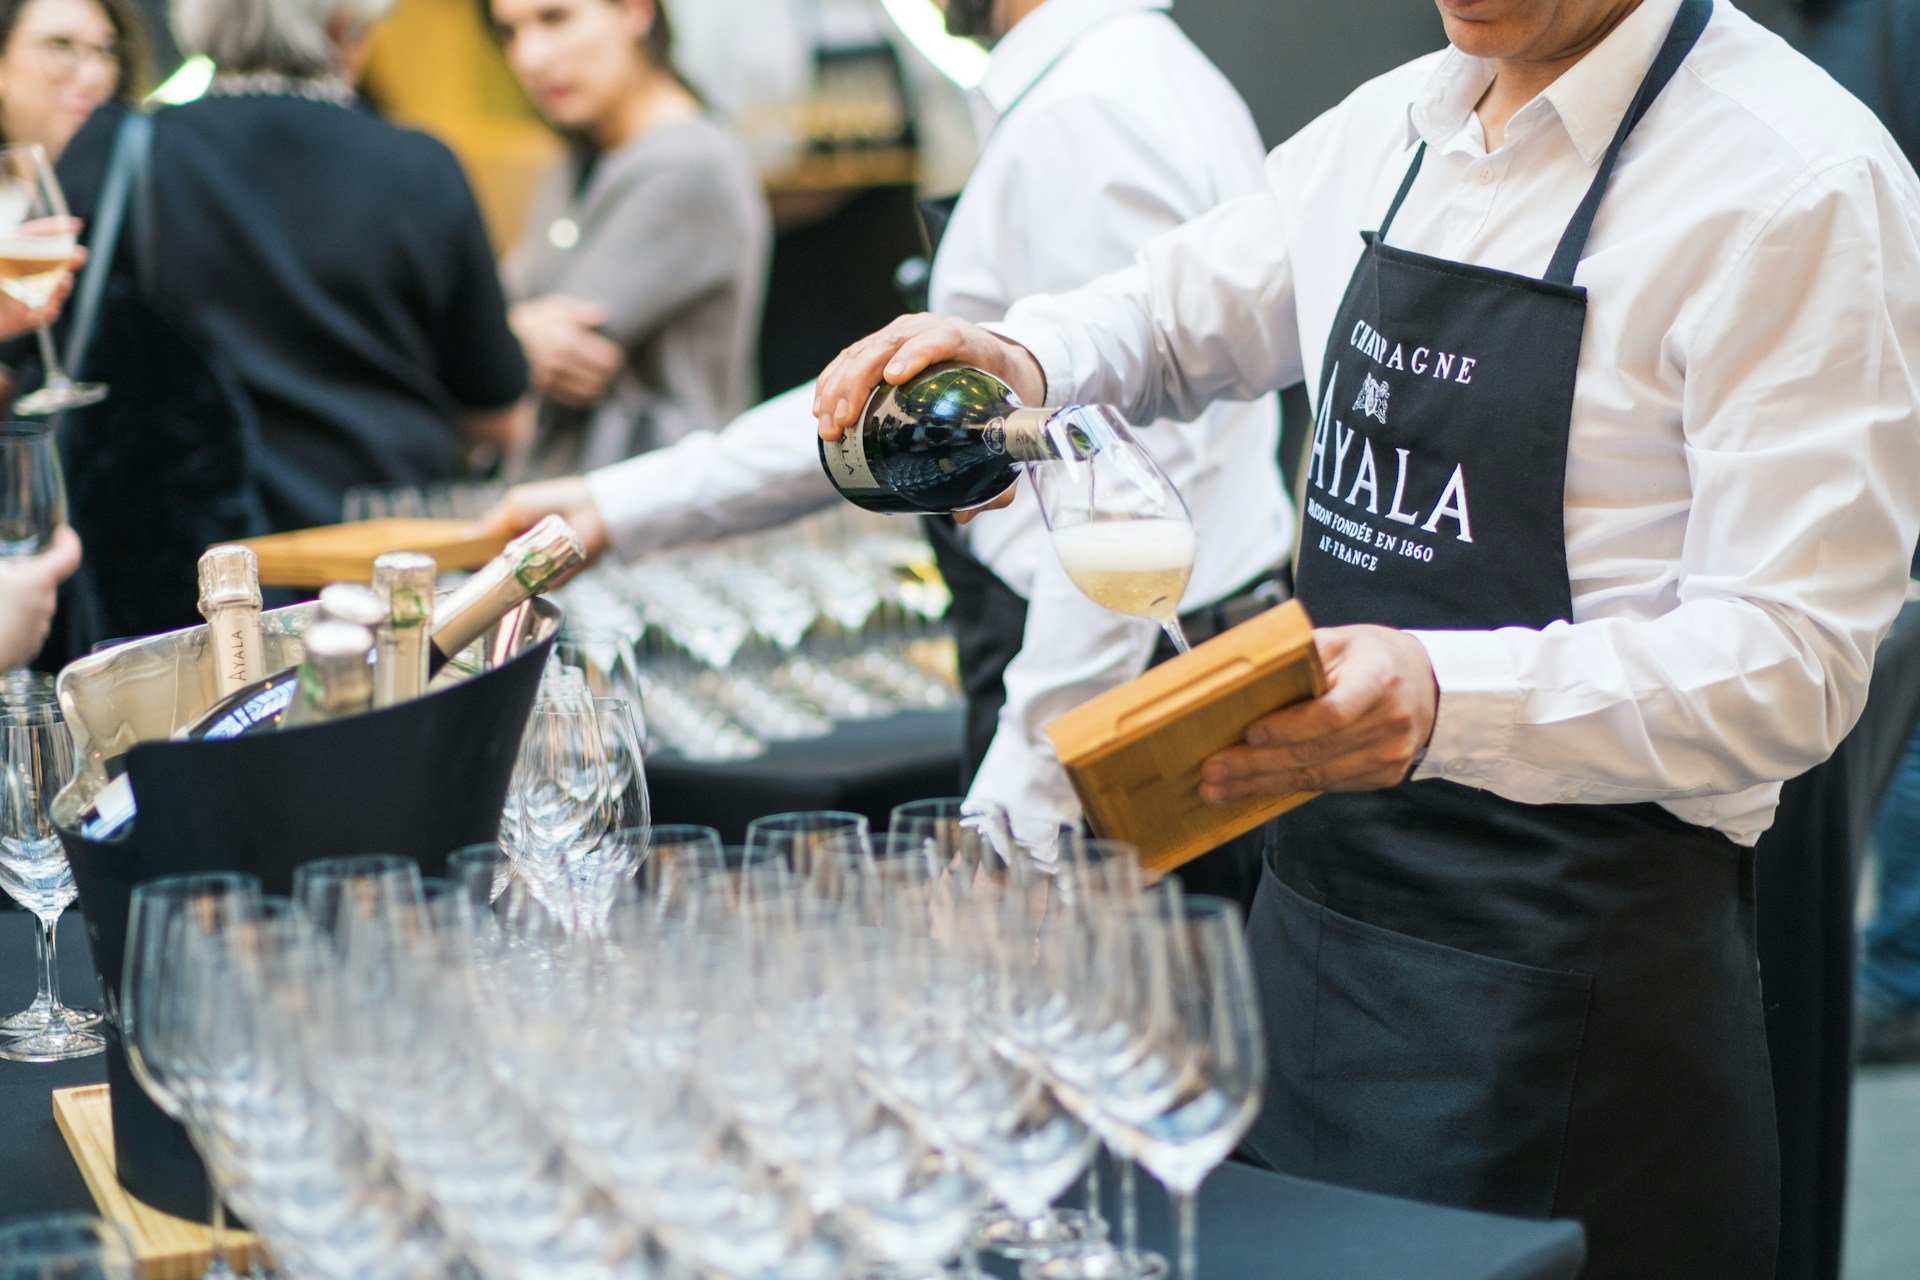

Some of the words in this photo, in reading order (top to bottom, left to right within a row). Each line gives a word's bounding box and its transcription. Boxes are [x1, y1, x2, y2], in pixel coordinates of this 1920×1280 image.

[1308, 360, 1473, 543] AYALA
[1331, 513, 1374, 544] FONDÉE
[1374, 531, 1397, 551] EN
[1398, 539, 1434, 562] 1860
[228, 630, 247, 681] AYALA
